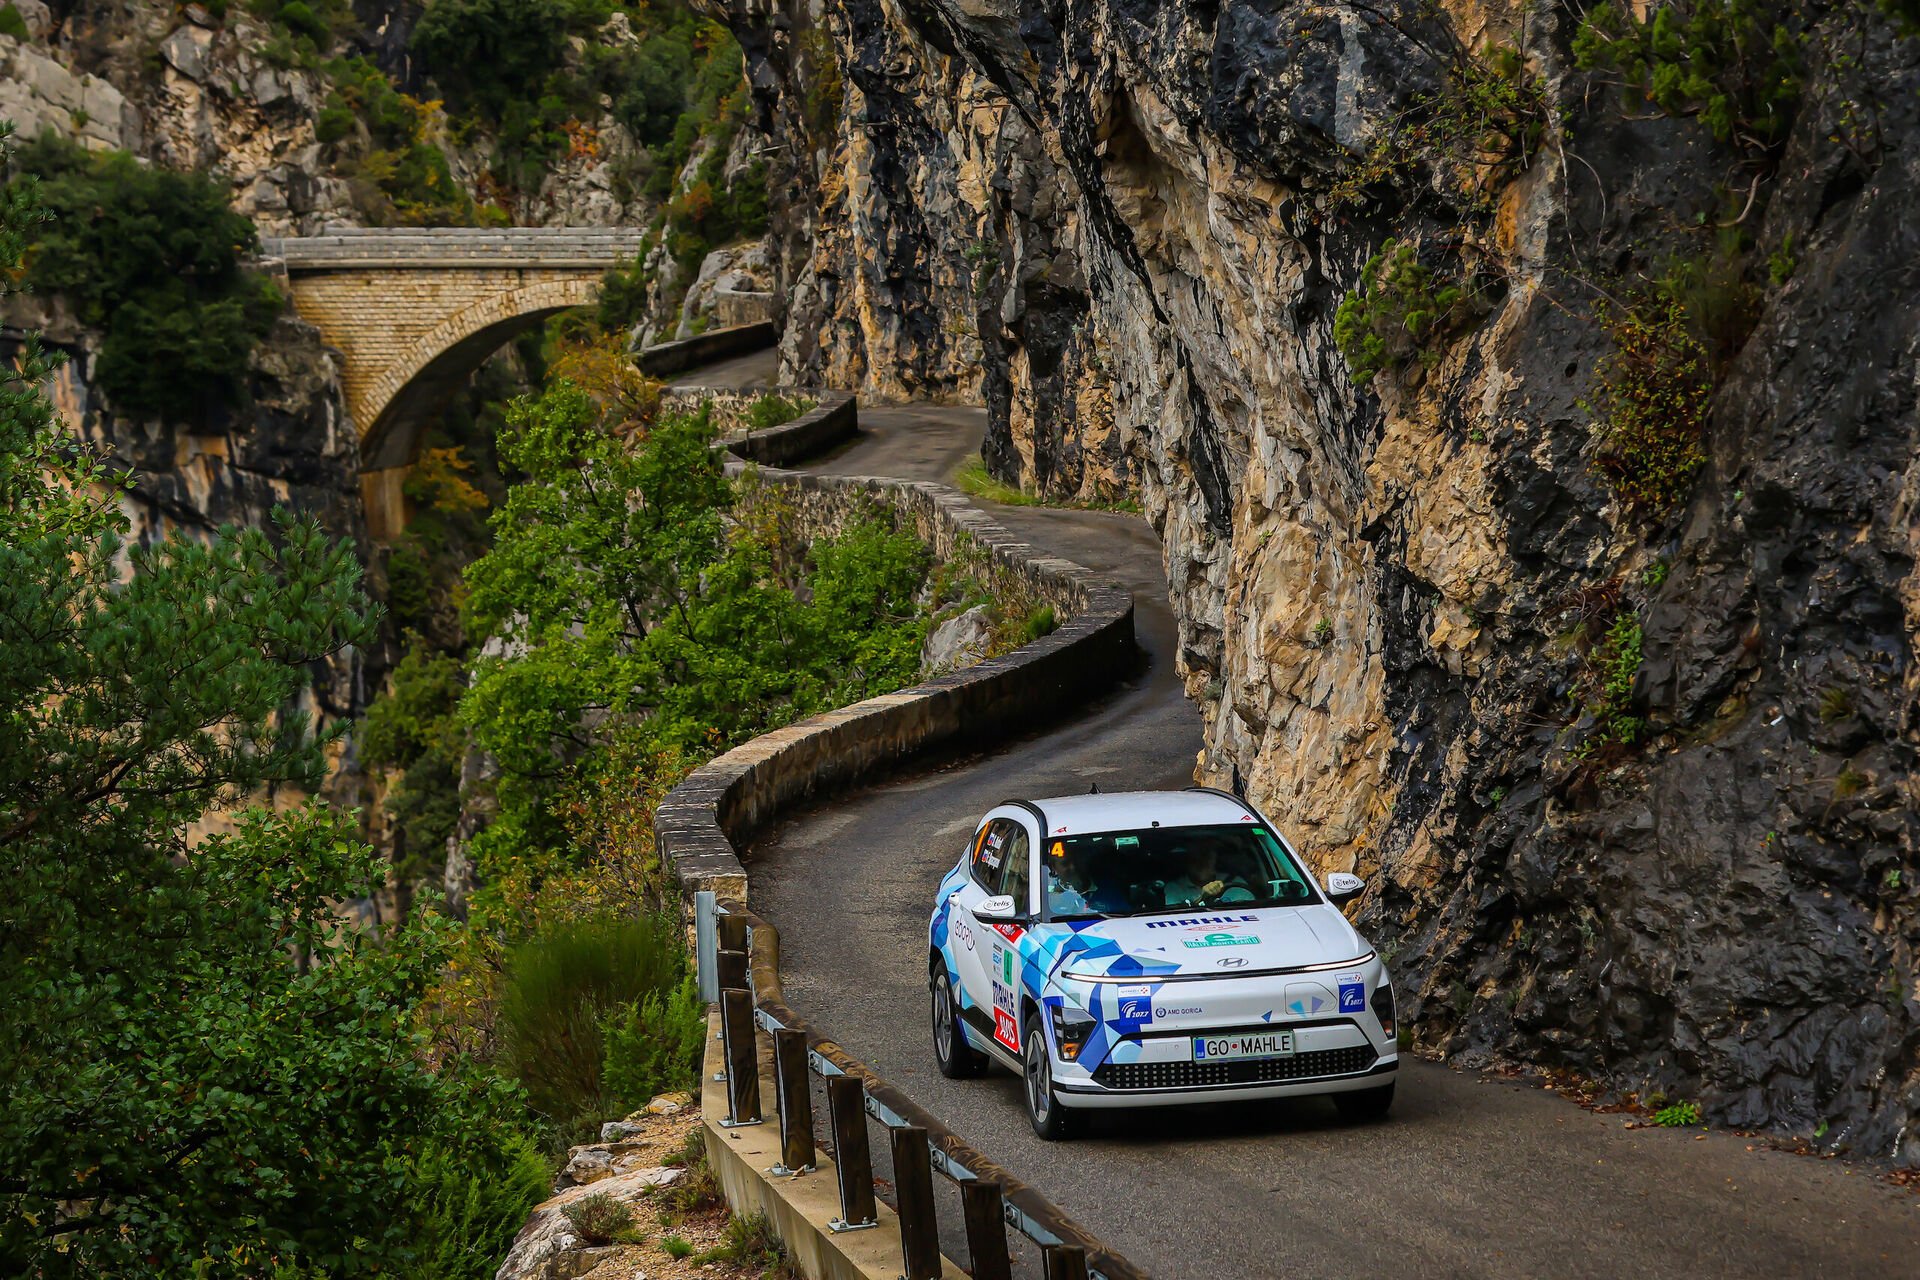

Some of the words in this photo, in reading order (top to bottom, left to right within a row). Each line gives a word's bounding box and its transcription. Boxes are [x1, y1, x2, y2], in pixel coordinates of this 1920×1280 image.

[1051, 842, 1064, 858] 4
[993, 899, 1010, 907] telis
[1145, 915, 1260, 929] MAHLE
[1207, 1039, 1229, 1056] GO
[1241, 1035, 1291, 1054] MAHLE
